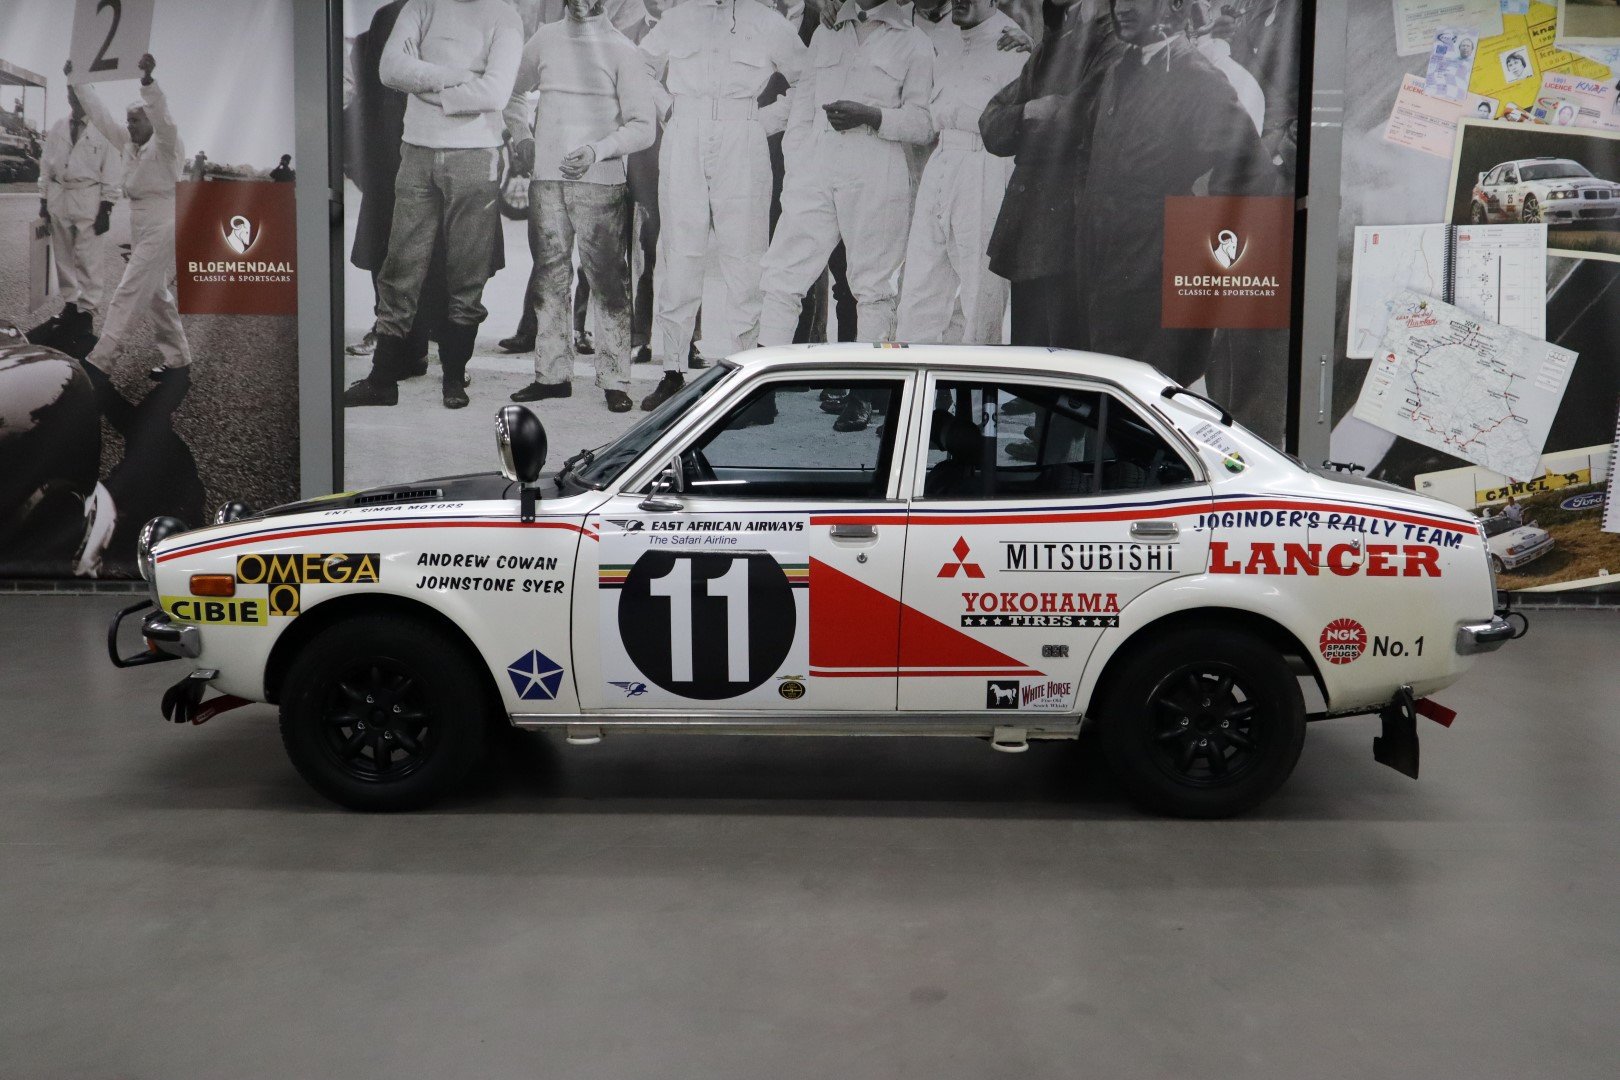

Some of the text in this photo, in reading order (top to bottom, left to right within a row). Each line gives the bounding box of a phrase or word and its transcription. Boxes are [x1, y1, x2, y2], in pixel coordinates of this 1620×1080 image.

[88, 0, 121, 72] 2
[1532, 24, 1557, 36] kna
[1544, 82, 1573, 92] LICENCE
[188, 261, 294, 273] BLOEMENDAAL
[1174, 275, 1280, 287] BLOEMENDAAL
[1485, 481, 1550, 501] CAMEL
[1572, 494, 1604, 508] Ford
[651, 521, 804, 532] EAST AFRICAN AIRWAYS
[1193, 511, 1320, 532] JOGINDER'S
[1328, 513, 1397, 538] RALLY
[649, 535, 738, 545] The Safari Airline
[417, 553, 558, 571] ANDREW COWAN
[1007, 544, 1173, 570] MITSUBISHI
[1208, 542, 1442, 577] LANCER
[236, 553, 379, 584] OMEGA
[416, 576, 565, 593] JOHNSTONE SYER
[961, 593, 1121, 612] YOKOHAMA
[650, 558, 750, 682] 11
[1009, 616, 1073, 626] TIRES
[1327, 629, 1360, 641] NGK
